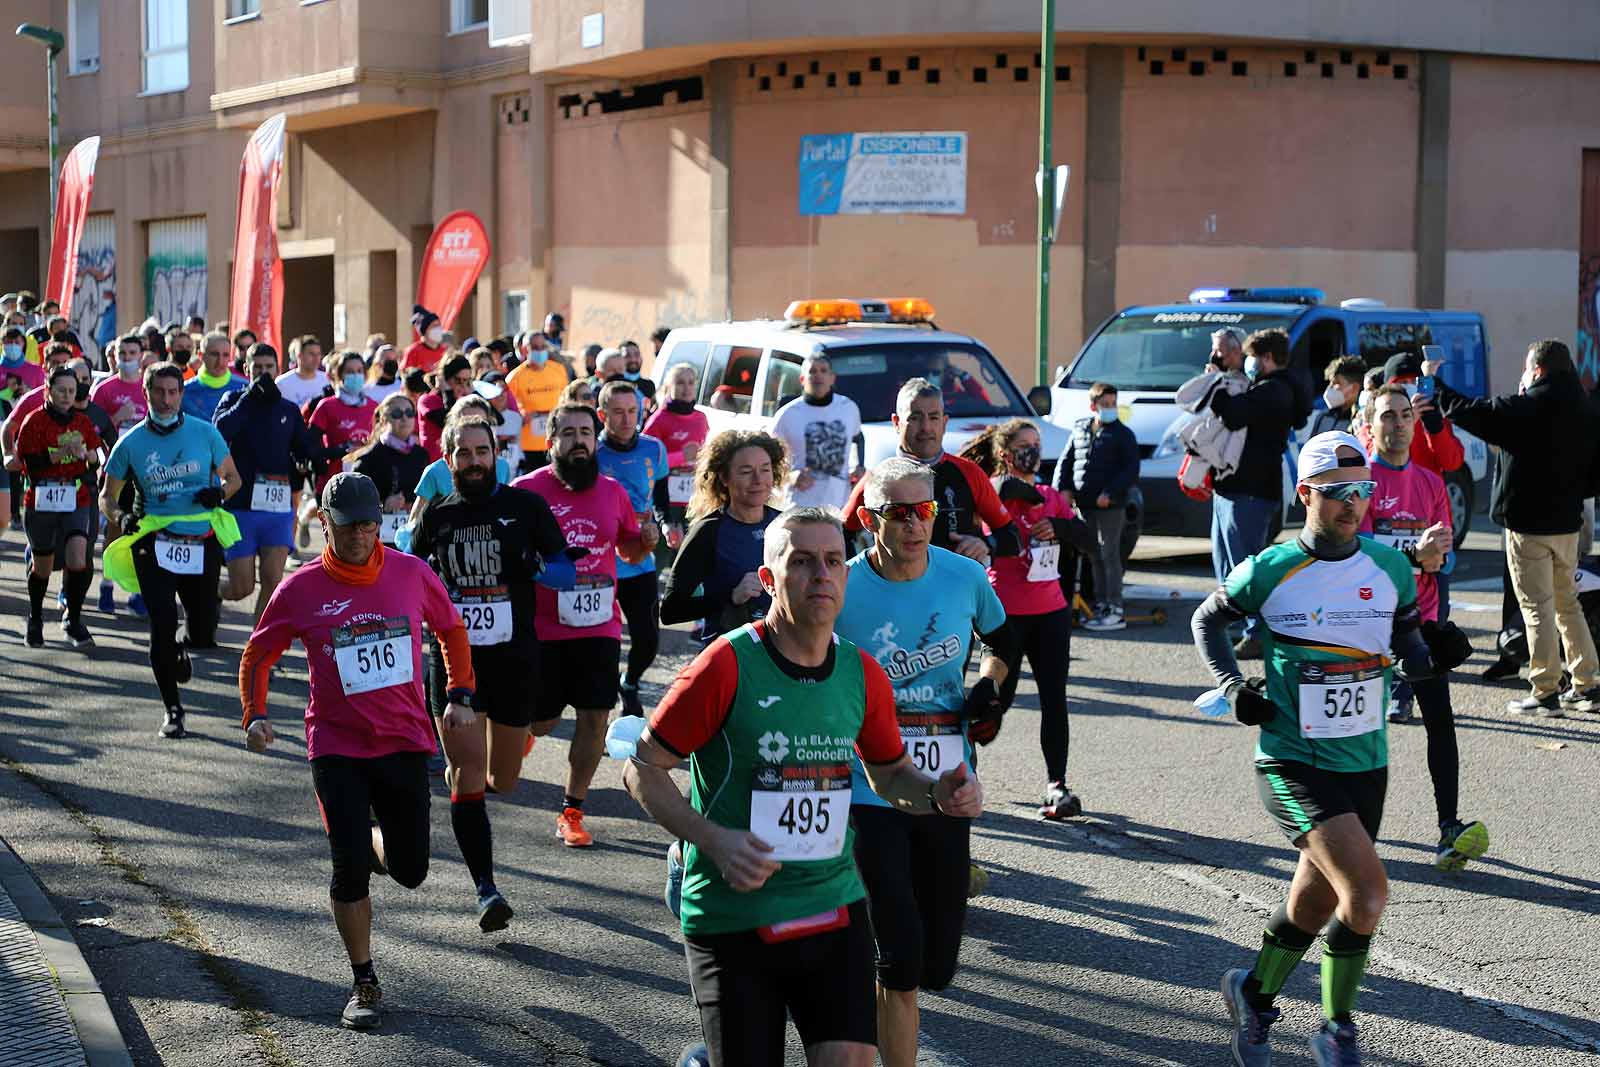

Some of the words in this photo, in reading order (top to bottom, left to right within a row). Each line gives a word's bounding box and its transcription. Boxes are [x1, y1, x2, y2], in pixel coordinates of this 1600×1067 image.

[802, 138, 847, 163] Portal
[863, 138, 957, 153] DISPONIBLE
[1153, 312, 1201, 323] Policía
[1203, 312, 1244, 323] Local
[265, 487, 284, 503] 198
[166, 546, 191, 564] 469
[463, 539, 502, 576] MIS
[573, 592, 601, 614] 438
[461, 606, 495, 631] 529
[357, 642, 396, 674] 516
[894, 685, 935, 702] AND
[1323, 685, 1366, 719] 526
[795, 736, 807, 746] La
[811, 735, 832, 746] ELA
[905, 741, 940, 771] 50
[778, 797, 831, 835] 495
